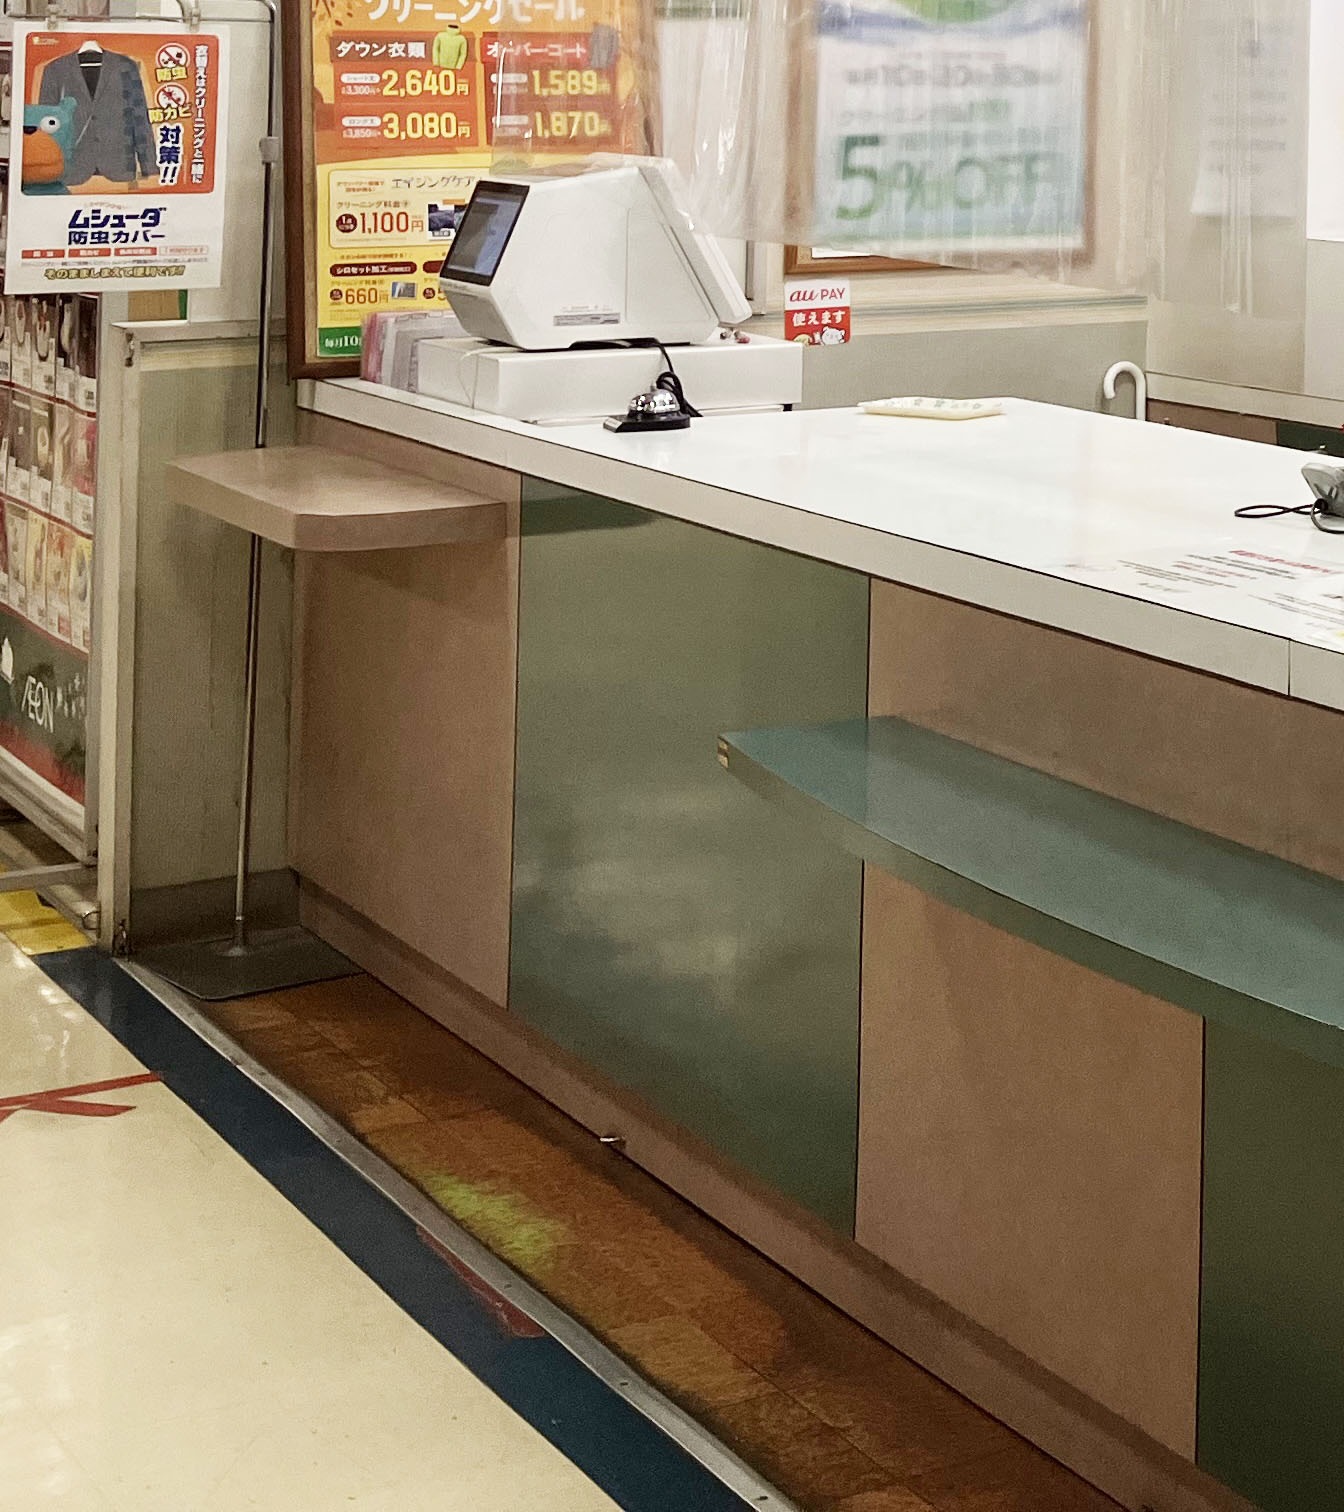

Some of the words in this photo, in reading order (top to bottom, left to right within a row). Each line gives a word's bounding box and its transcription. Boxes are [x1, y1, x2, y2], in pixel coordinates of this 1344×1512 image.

[335, 40, 426, 59] ダウン衣類
[486, 41, 587, 60] オーバーコート
[156, 66, 188, 82] 防虫
[149, 102, 194, 123] 防カビ
[392, 175, 482, 189] エイジングケア
[68, 207, 167, 229] ムシューダ
[68, 230, 166, 245] 防虫カバー
[790, 290, 819, 302] au
[821, 288, 845, 300] PAY
[793, 310, 845, 326] 使えます
[325, 334, 360, 348] 毎月10
